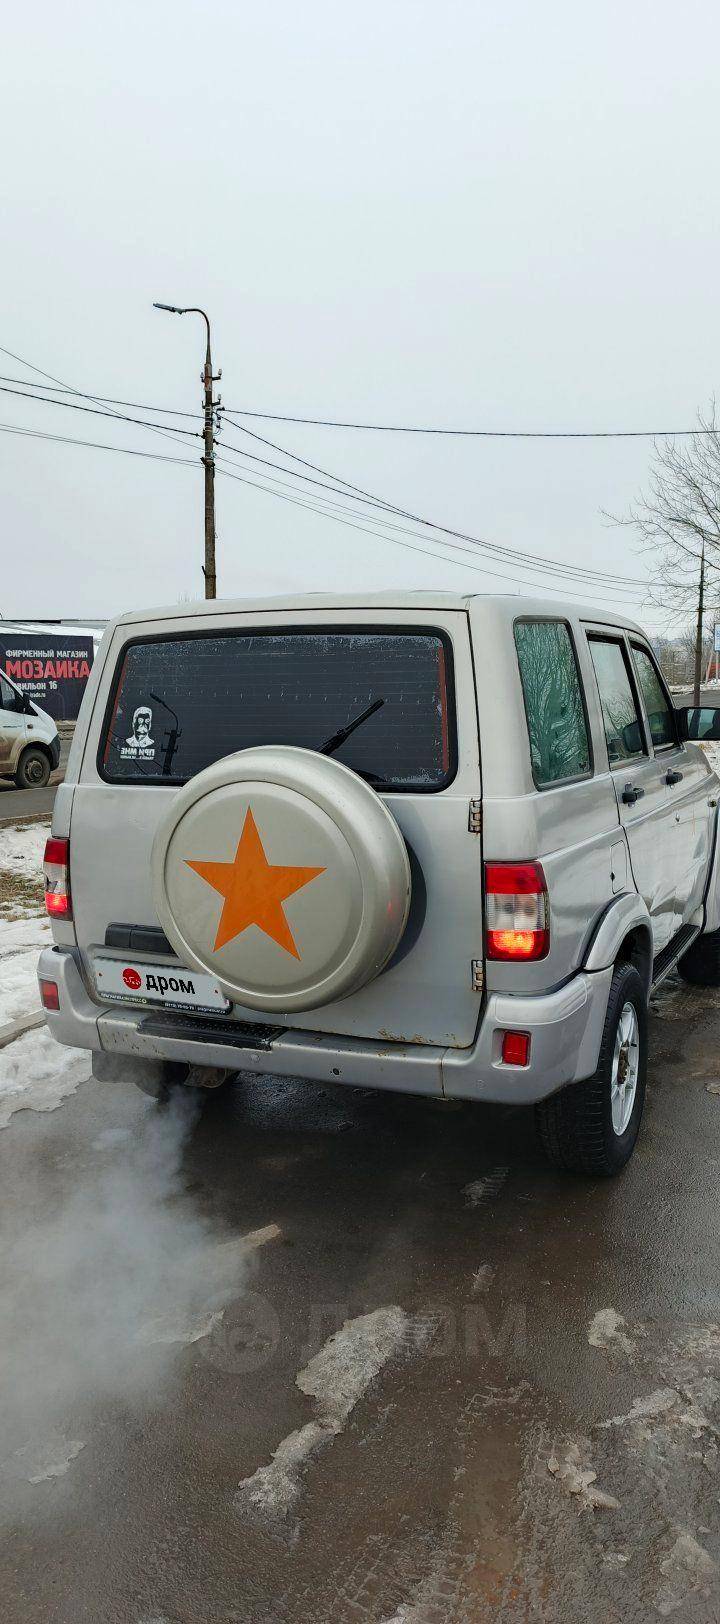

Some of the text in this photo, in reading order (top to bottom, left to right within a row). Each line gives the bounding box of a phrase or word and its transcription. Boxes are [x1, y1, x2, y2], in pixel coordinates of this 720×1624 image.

[6, 649, 88, 658] ФИРМЕННЫЙ МАГАЗИН
[48, 681, 58, 690] 16
